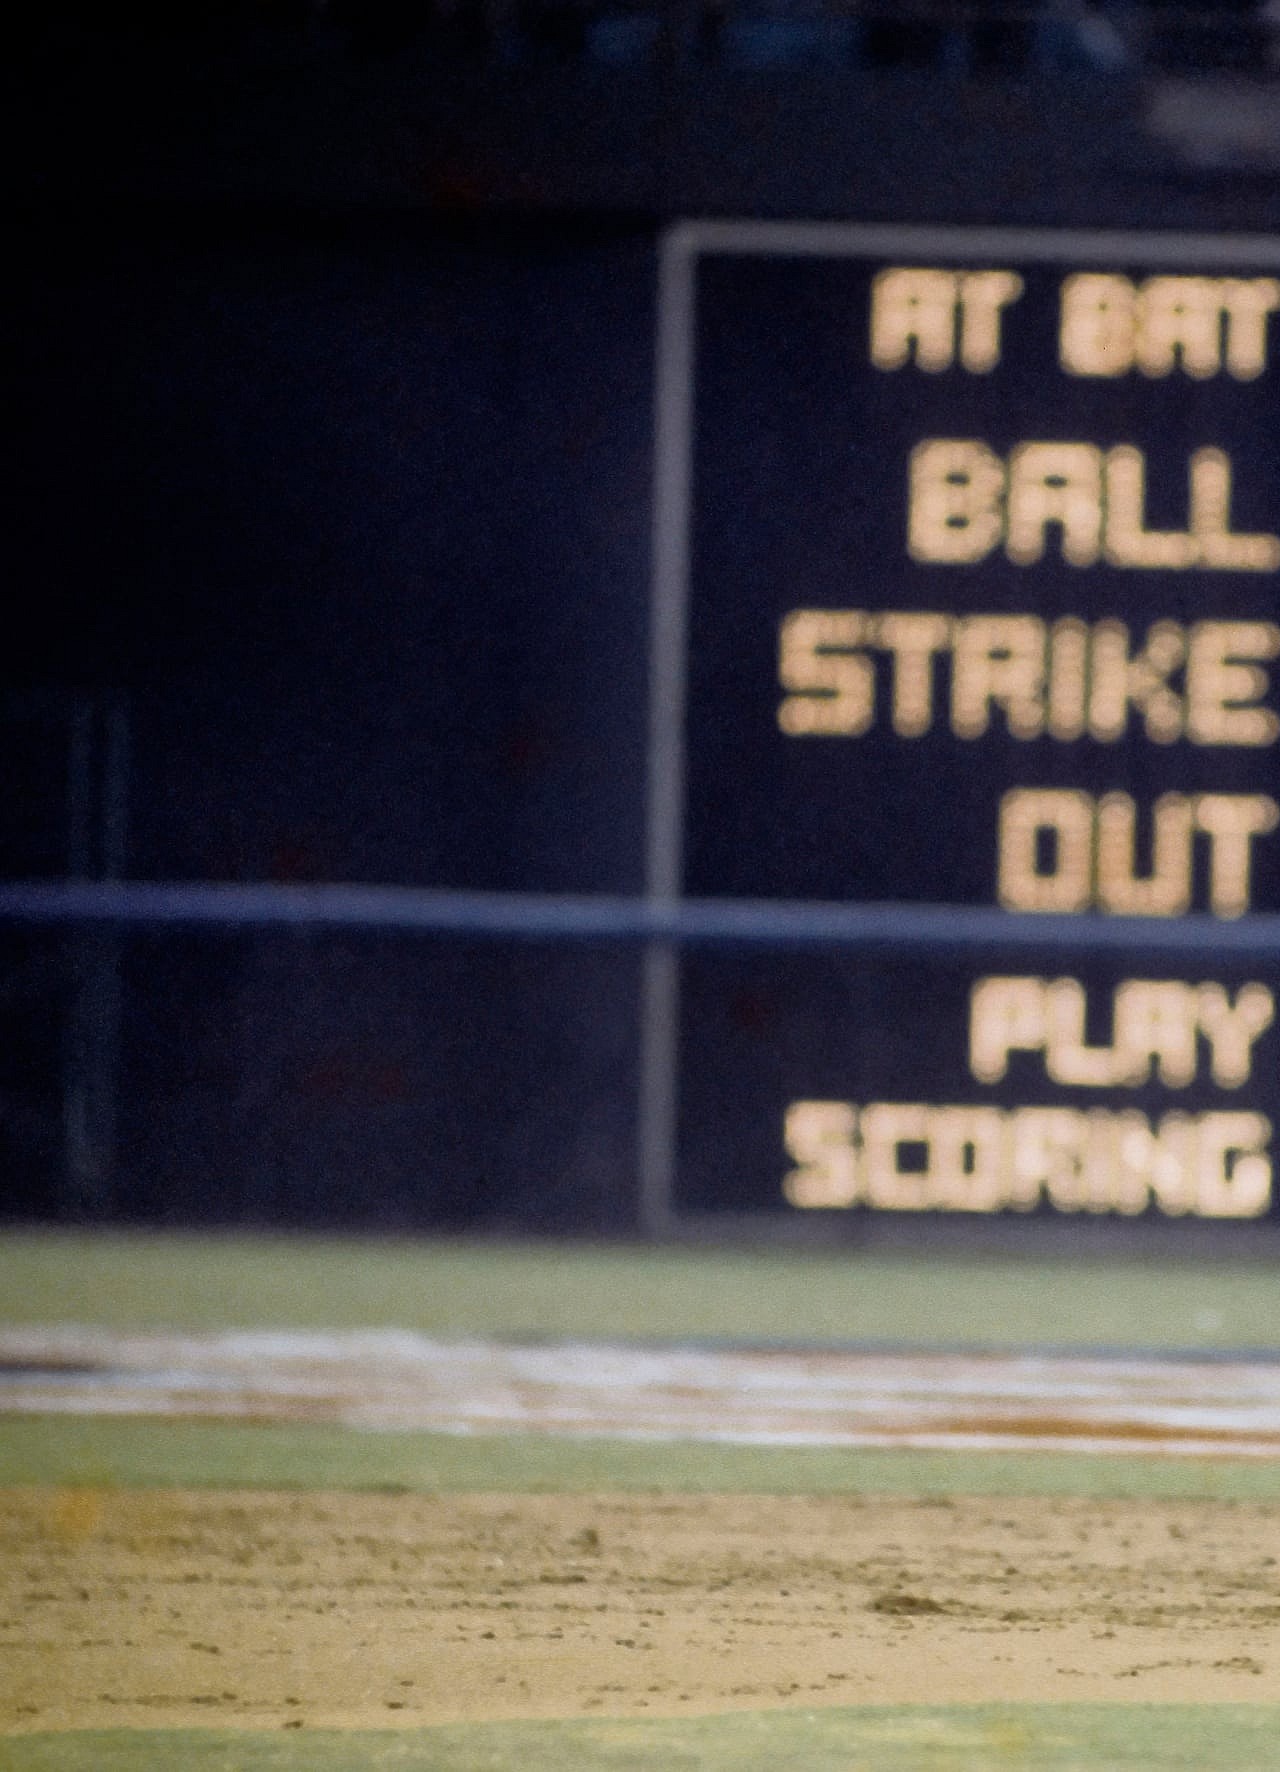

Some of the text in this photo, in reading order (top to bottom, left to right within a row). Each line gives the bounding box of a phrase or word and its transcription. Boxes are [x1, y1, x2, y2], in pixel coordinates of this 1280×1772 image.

[870, 267, 1023, 372] AT
[997, 786, 1280, 919] OUT
[967, 973, 1277, 1088] PLAY
[782, 1098, 1274, 1219] SCORING
